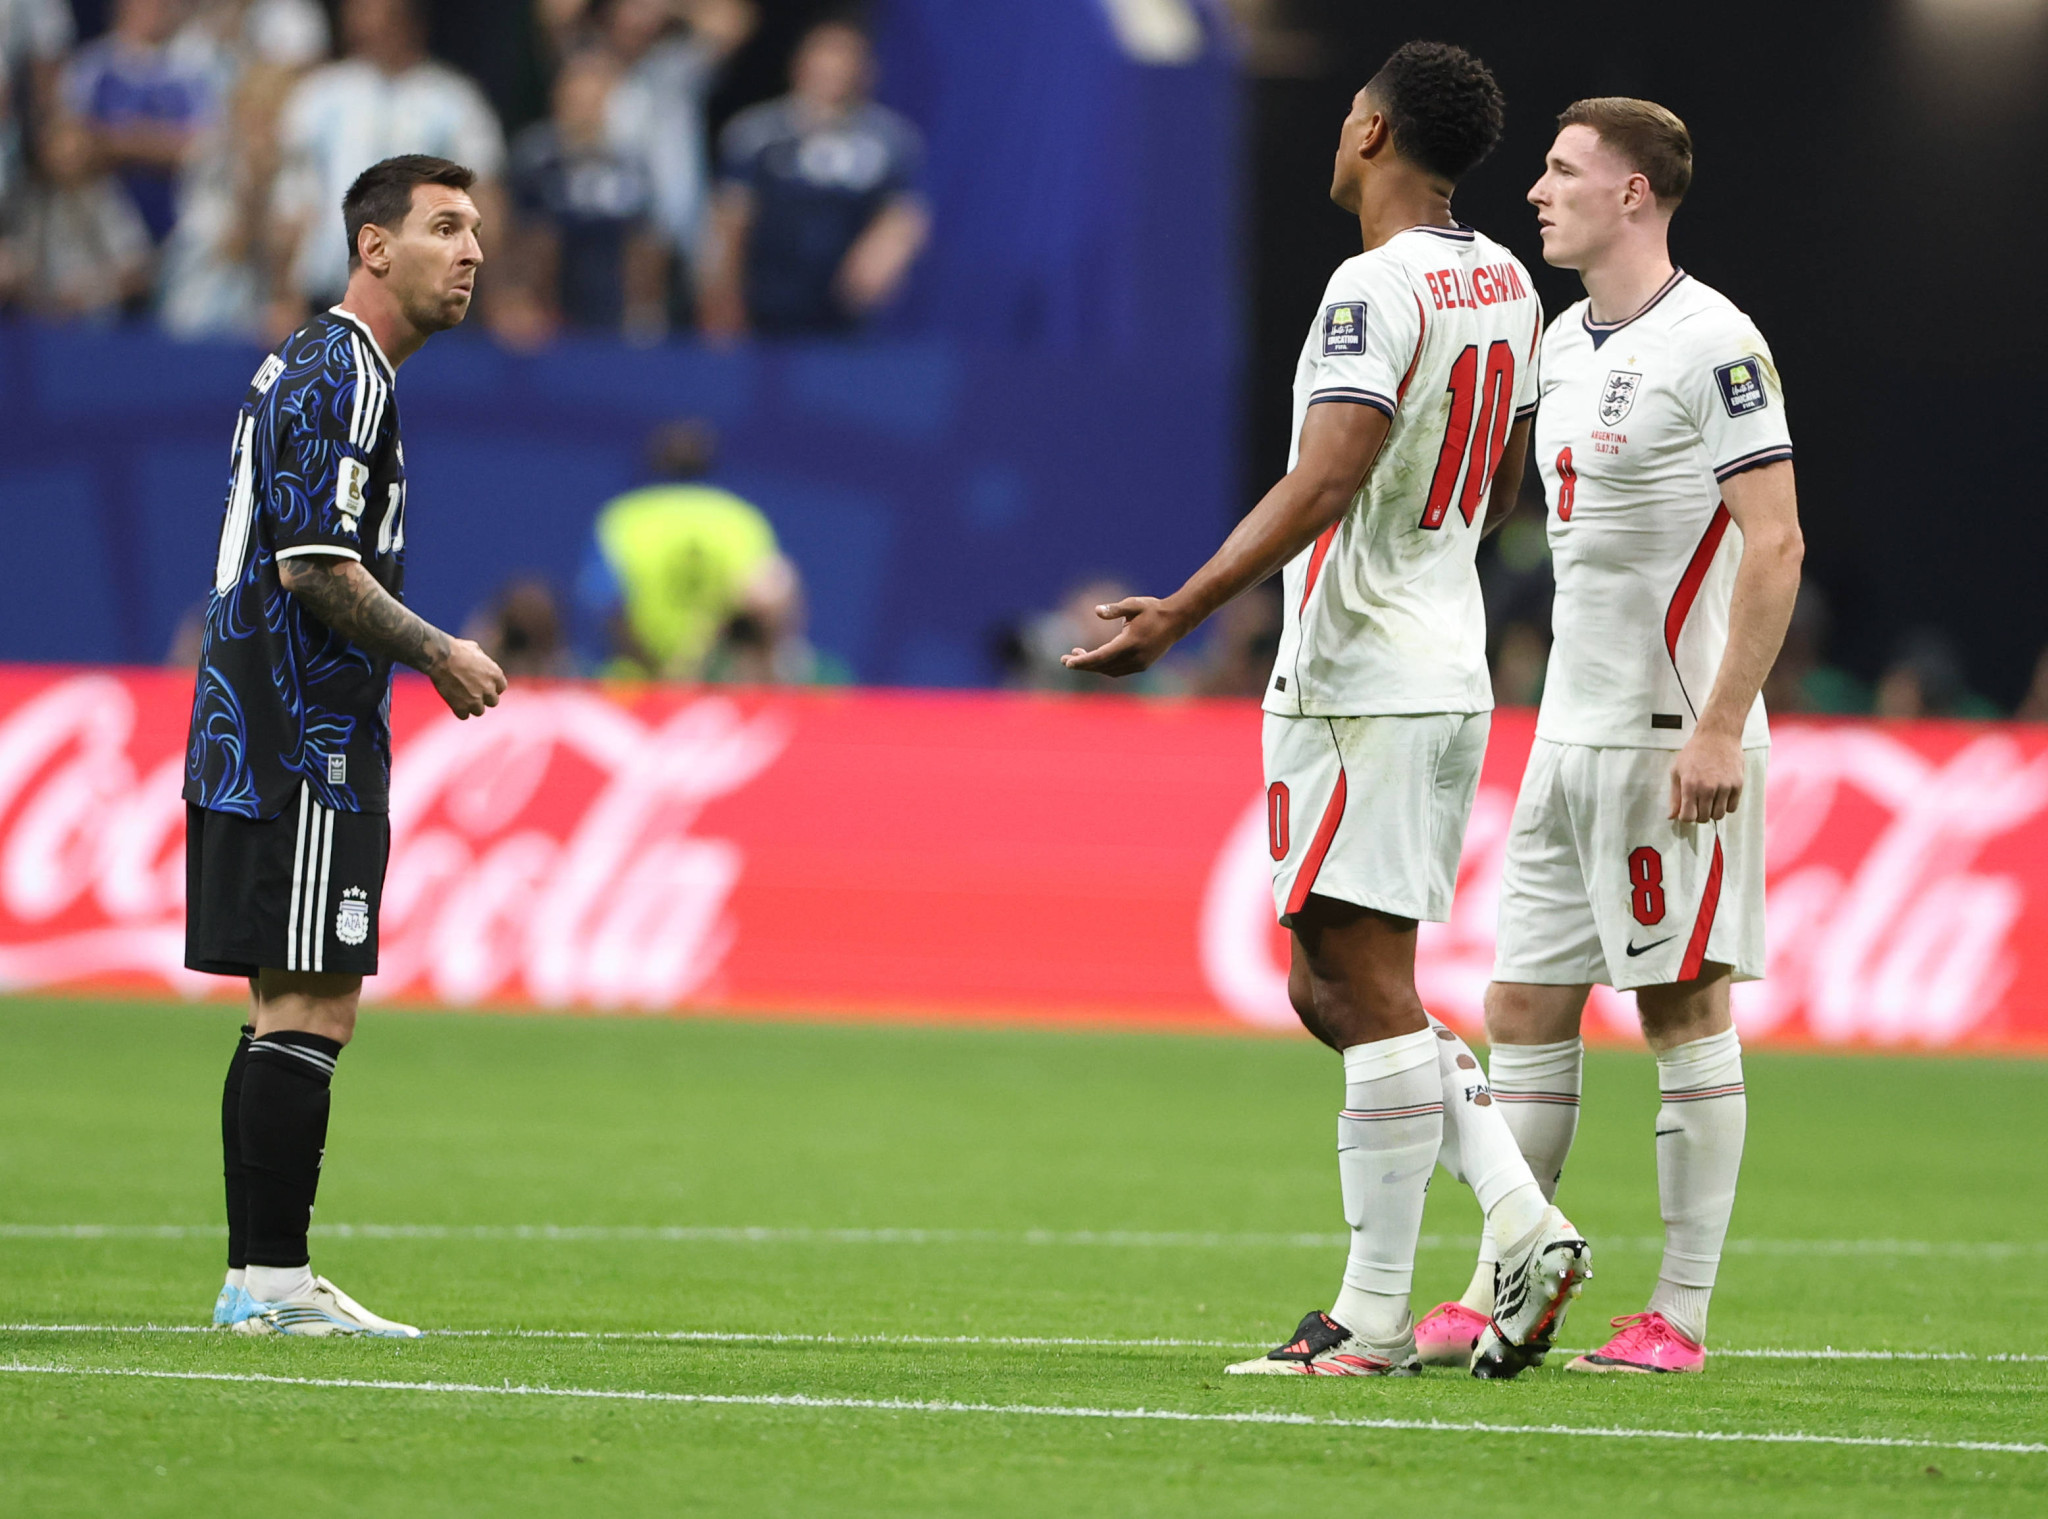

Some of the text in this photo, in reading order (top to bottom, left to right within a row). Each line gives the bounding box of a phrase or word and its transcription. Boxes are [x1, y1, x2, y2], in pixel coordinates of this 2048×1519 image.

[1418, 339, 1514, 530] 10
[1591, 430, 1627, 444] ARGENTINA
[1556, 446, 1577, 522] 8
[1628, 846, 1666, 926] 8
